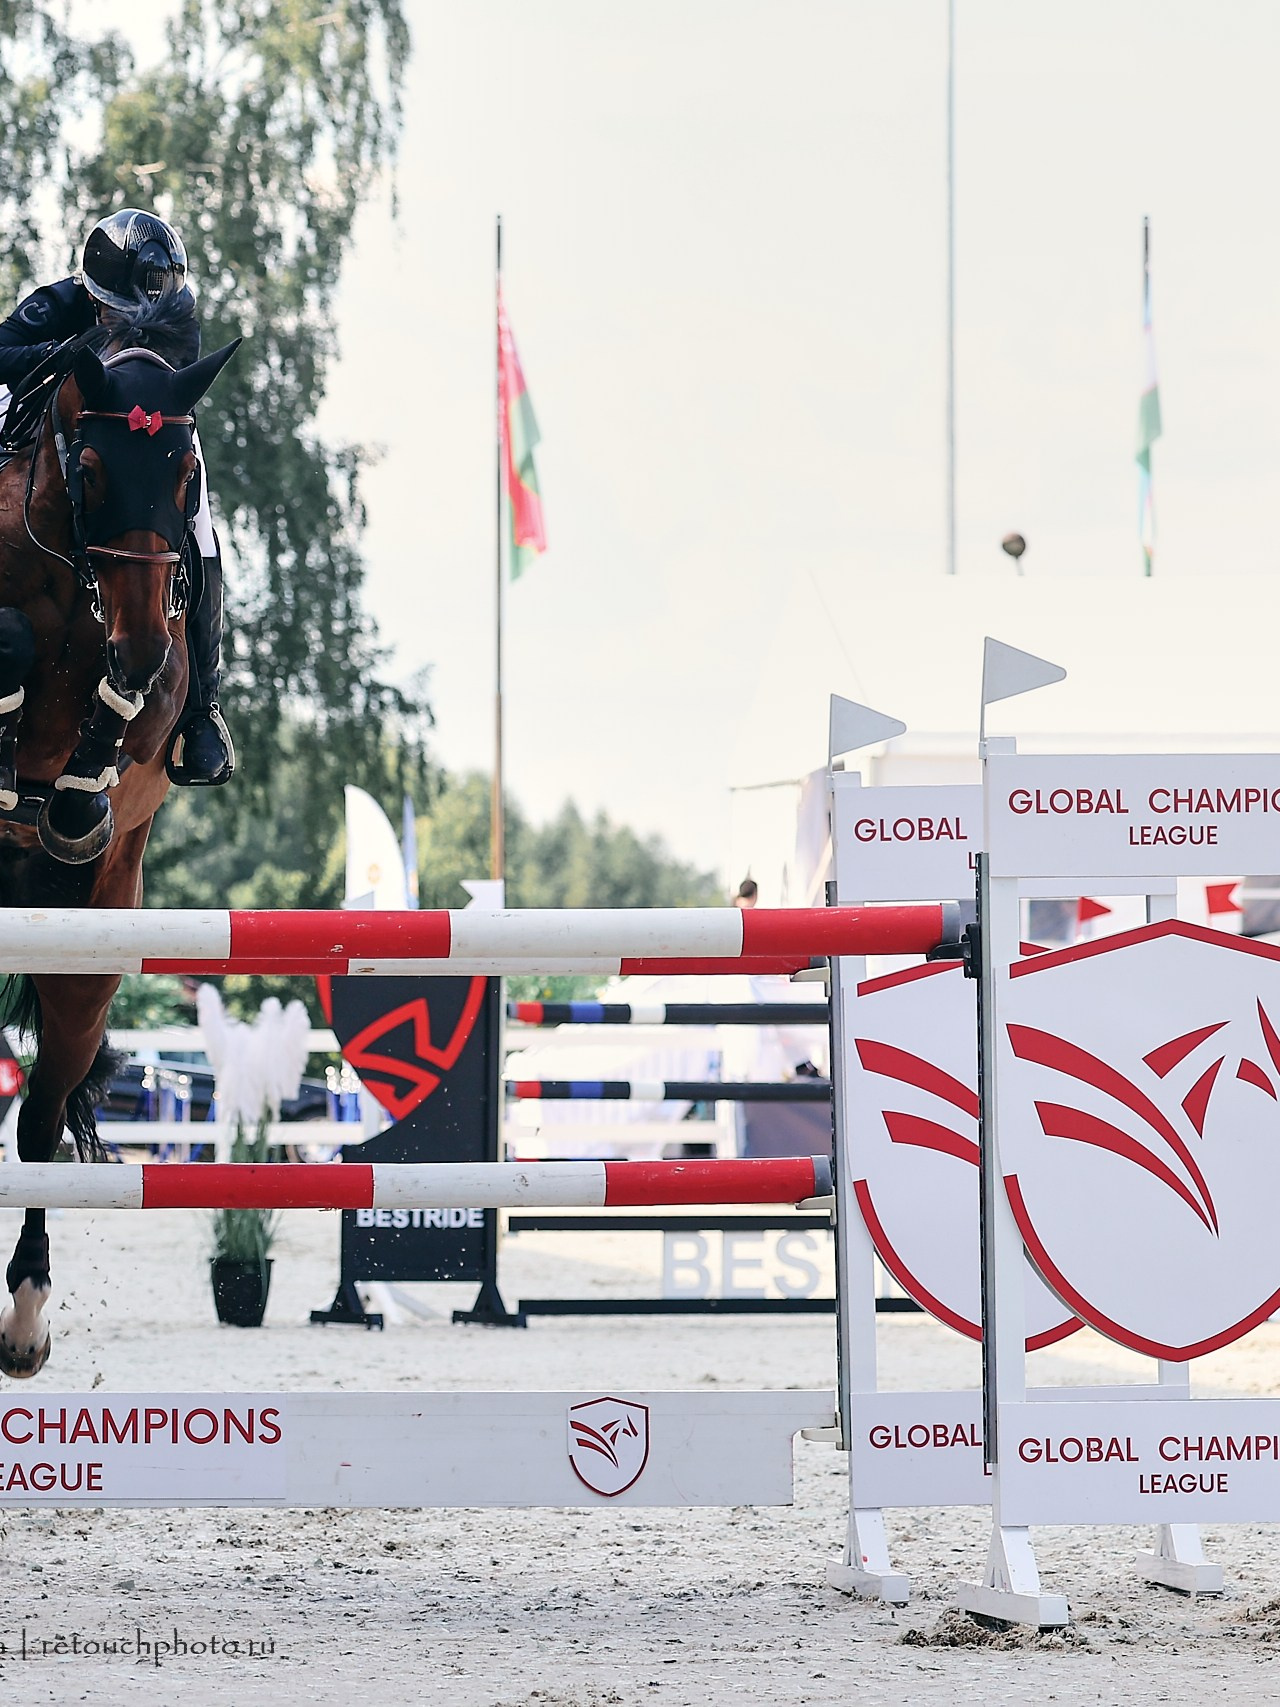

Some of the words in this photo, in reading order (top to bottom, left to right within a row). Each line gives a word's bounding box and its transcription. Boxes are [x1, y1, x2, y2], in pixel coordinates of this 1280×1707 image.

[1008, 788, 1129, 815] GLOBAL
[854, 817, 968, 842] GLOBAL
[1129, 825, 1218, 846] LEAGUE
[356, 1208, 485, 1229] BESTRIDE
[663, 1229, 833, 1299] BES
[0, 1407, 282, 1445] CHAMPIONS
[869, 1423, 983, 1449] GLOBAL
[1018, 1437, 1139, 1463] GLOBAL
[1139, 1473, 1228, 1494] LEAGUE
